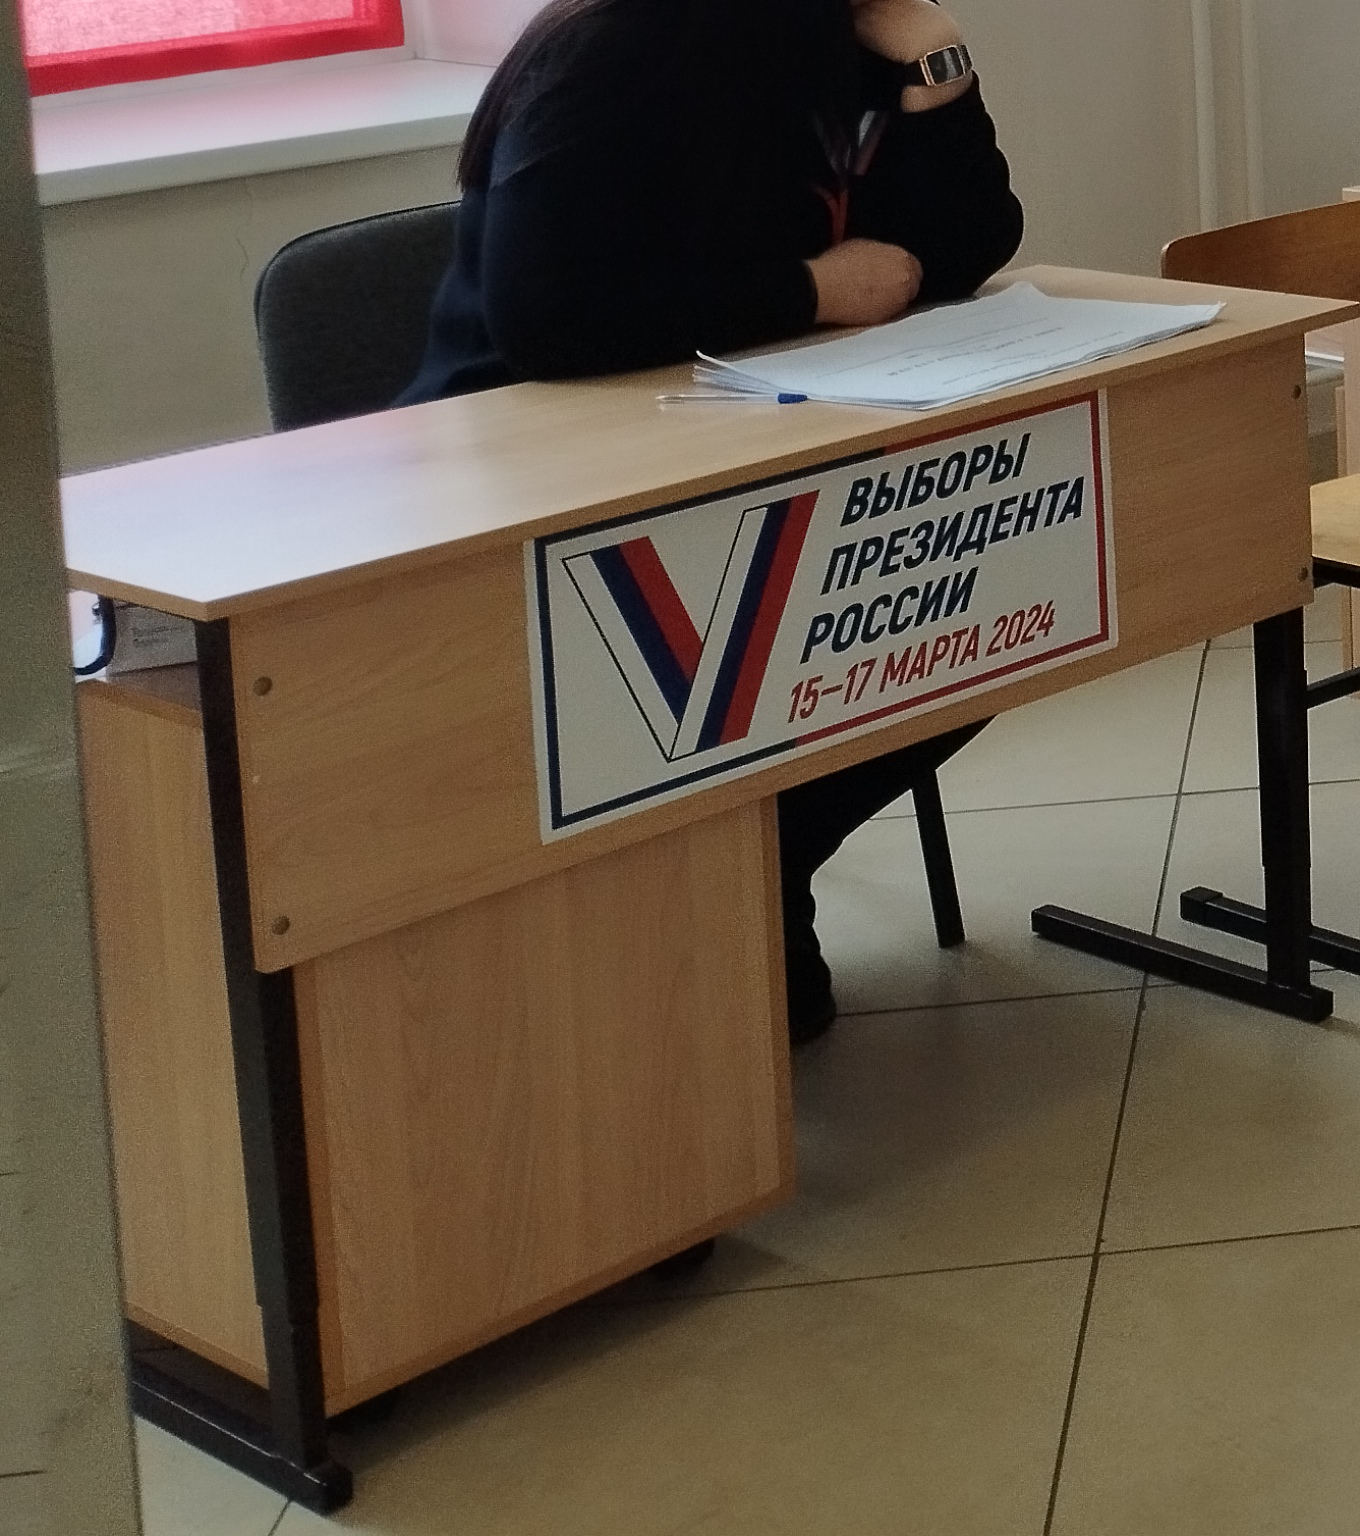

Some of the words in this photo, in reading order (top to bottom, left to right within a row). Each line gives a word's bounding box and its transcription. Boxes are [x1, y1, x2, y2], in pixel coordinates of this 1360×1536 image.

[840, 433, 1031, 527] ВЫБОРЫ
[820, 476, 1085, 596] ПРЕЗИДЕНТА
[800, 566, 979, 664] РОССИИ
[879, 624, 981, 694] МАРТА
[985, 600, 1056, 658] 2024
